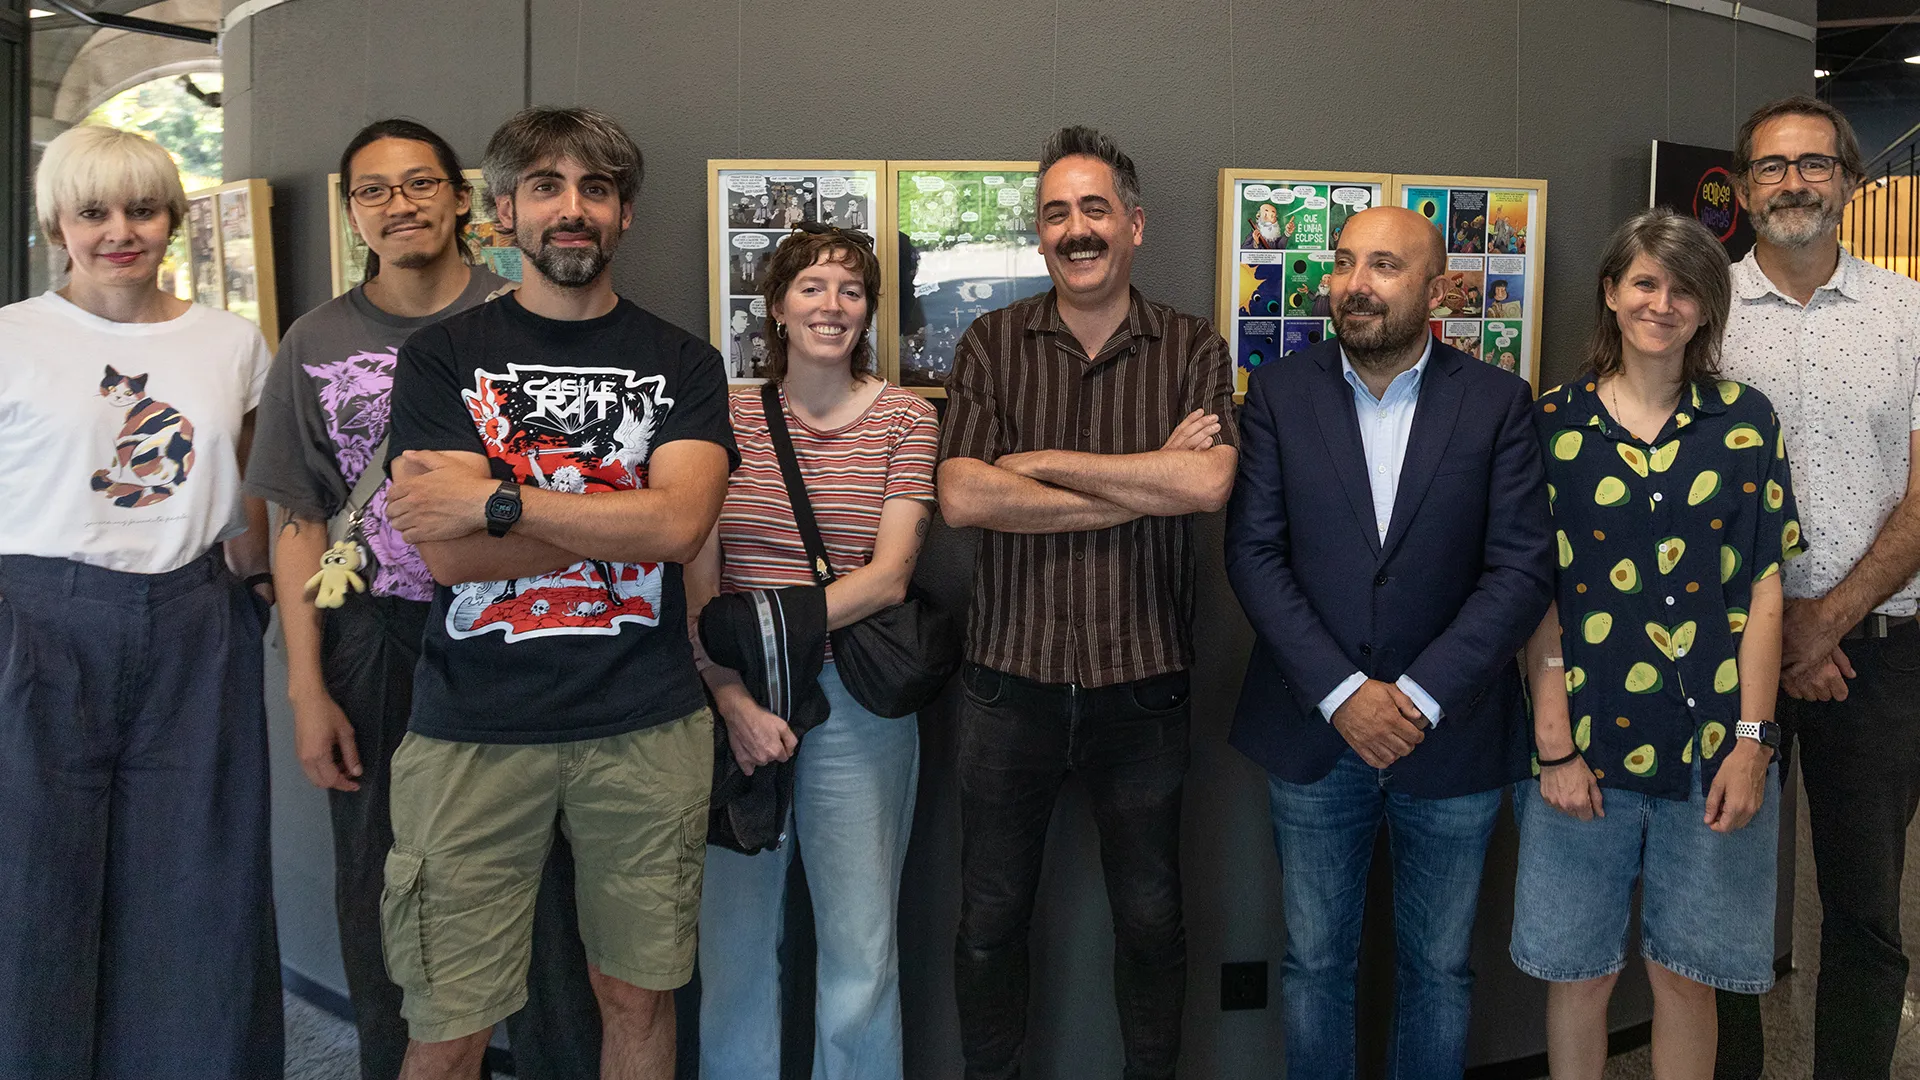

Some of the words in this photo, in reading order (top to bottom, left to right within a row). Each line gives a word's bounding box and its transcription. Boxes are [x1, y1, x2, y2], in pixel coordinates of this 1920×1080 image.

[1702, 181, 1730, 207] eclipse
[1297, 221, 1302, 233] É
[1303, 223, 1323, 233] UNHA
[1303, 214, 1318, 223] QUE
[523, 376, 617, 397] CASTLE
[522, 391, 618, 423] RAT
